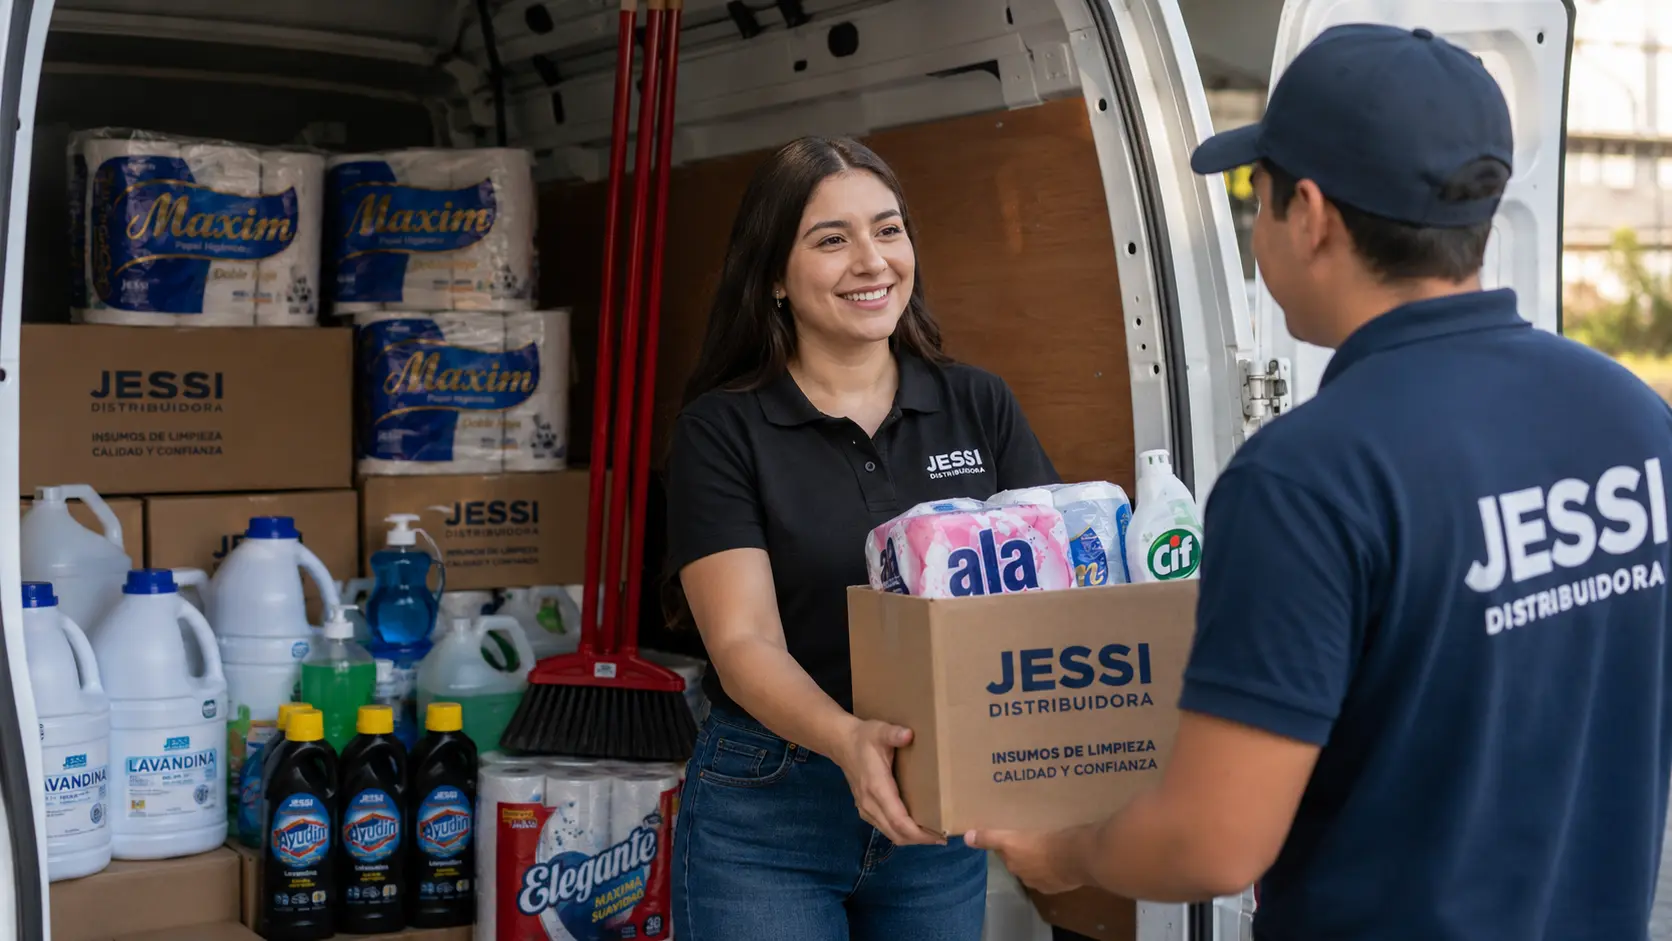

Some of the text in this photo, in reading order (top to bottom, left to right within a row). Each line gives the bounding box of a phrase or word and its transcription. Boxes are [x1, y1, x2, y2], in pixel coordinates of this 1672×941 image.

[126, 192, 292, 241] Maxim
[344, 193, 491, 238] Maxim
[90, 370, 224, 399] JESSI
[383, 351, 533, 394] Maxim
[90, 402, 223, 412] DISTRIBUIDORA
[92, 431, 223, 442] INSUMOS DE LIMPIEZA
[92, 446, 223, 457] CALIDAD Y CONFIANZA
[926, 448, 982, 472] JESSI
[445, 500, 539, 526] JESSI
[1464, 456, 1668, 593] JESSI
[947, 528, 1040, 598] ala
[1152, 534, 1195, 575] Cif
[1485, 560, 1666, 636] DISTRIBUIDORA
[985, 642, 1152, 695] JESSI
[989, 692, 1154, 717] DISTRIBUIDORA
[129, 752, 215, 773] LAVANDINA
[992, 739, 1156, 764] INSUMOS DE LIMPIEZA
[45, 768, 107, 792] VANDINA
[993, 758, 1158, 783] CALIDAD Y CONFIANZA
[519, 828, 657, 914] Elegante
[592, 890, 645, 924] SUAVIDAD
[594, 876, 643, 908] MAXIMA
